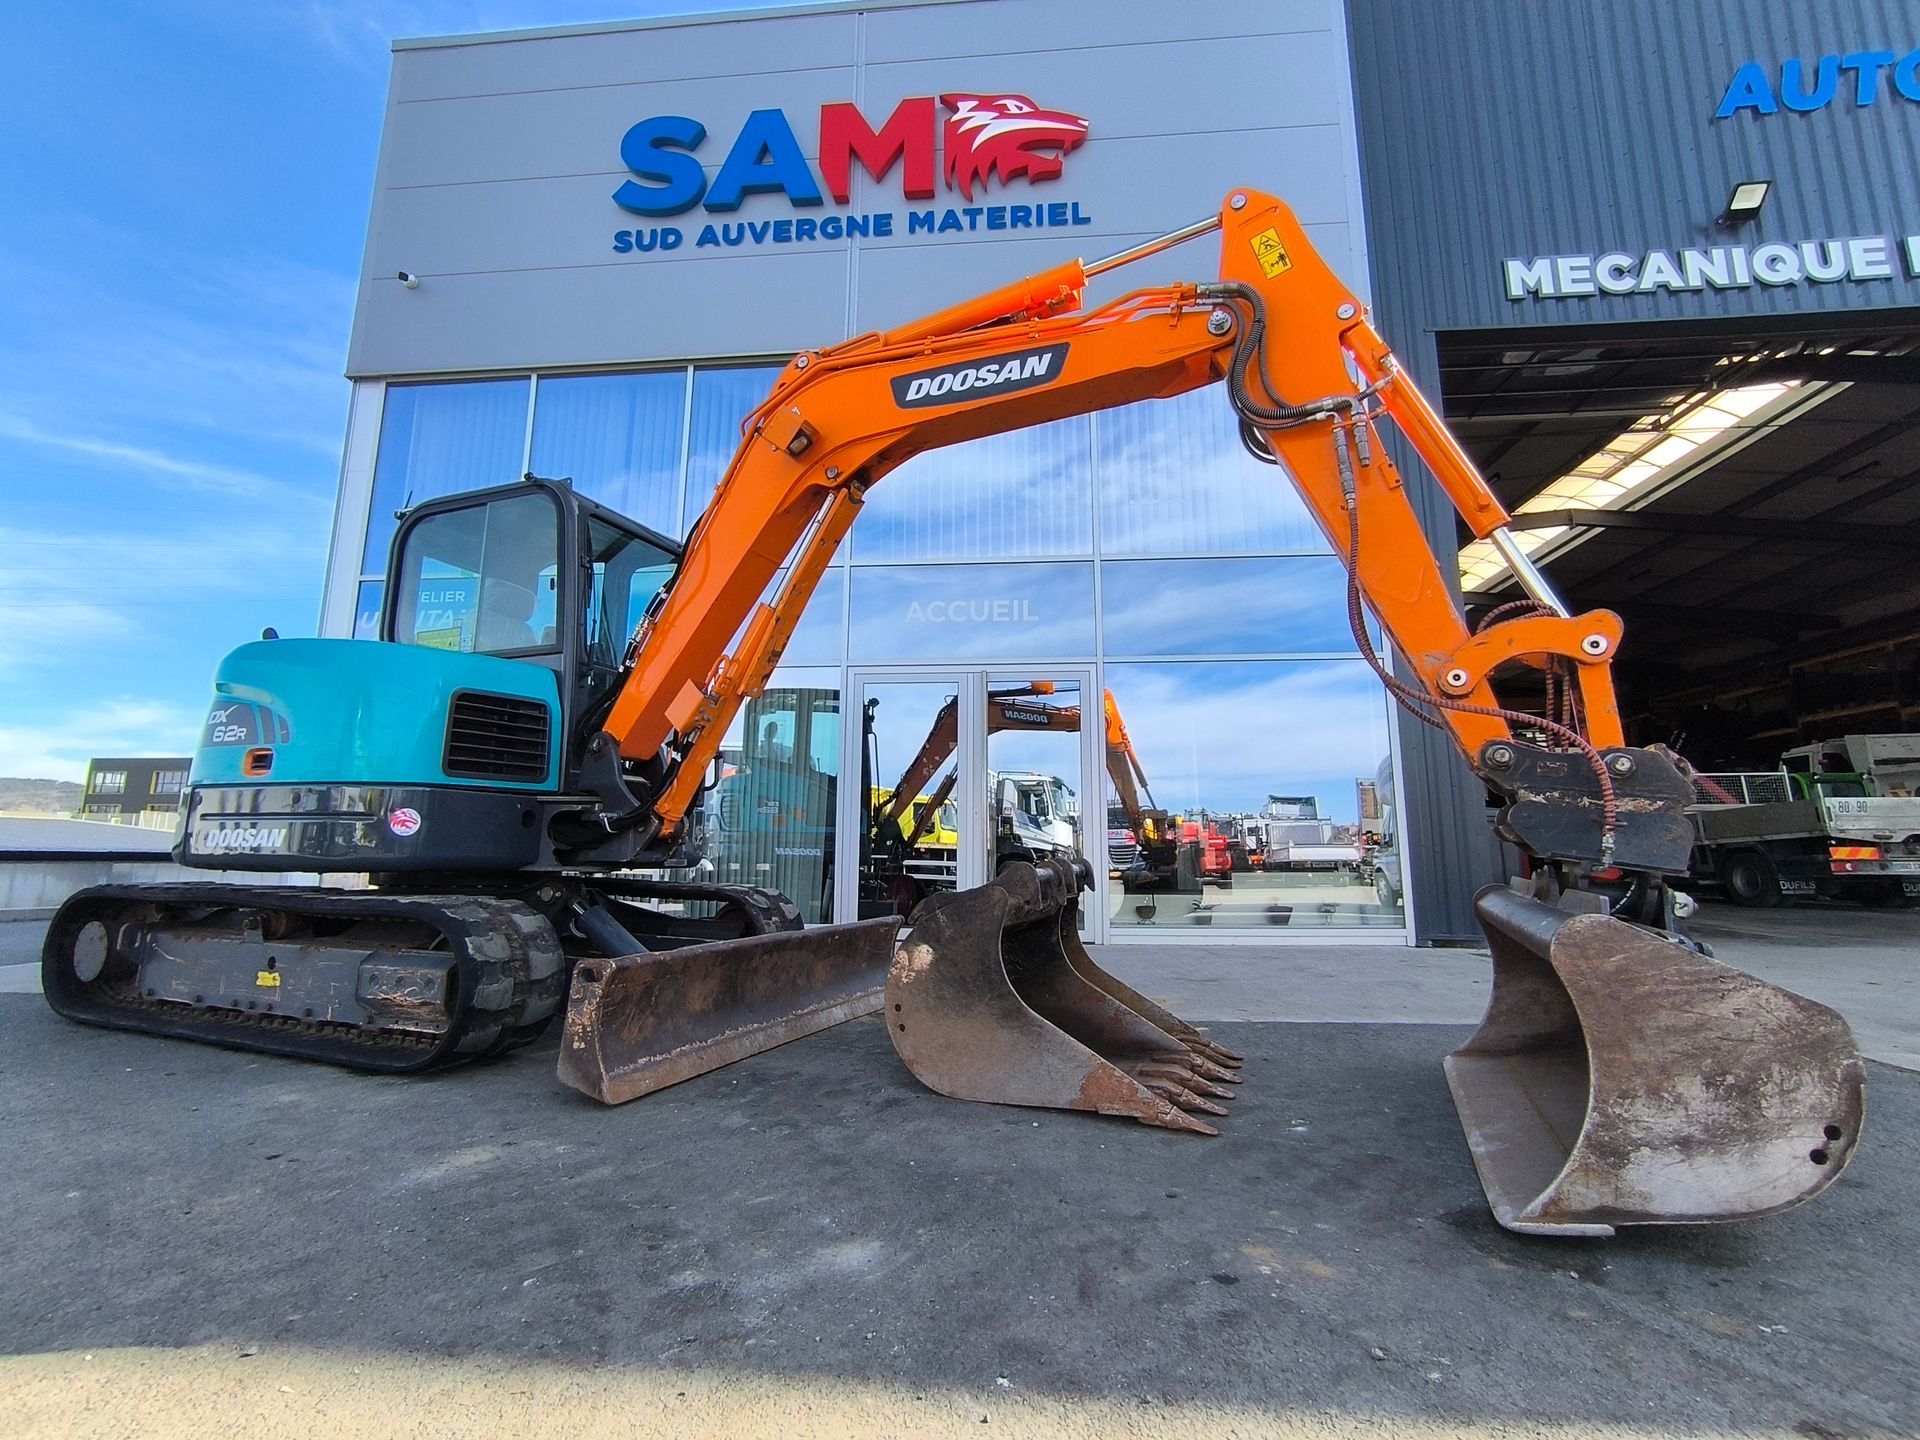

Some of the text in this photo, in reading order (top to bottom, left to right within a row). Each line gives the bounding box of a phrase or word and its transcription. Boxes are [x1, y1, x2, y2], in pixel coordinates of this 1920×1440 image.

[611, 96, 936, 217] SAM
[612, 202, 1091, 253] SUD AUVERGNE MATERIEL
[1504, 236, 1893, 300] MECANIQUE
[904, 351, 1053, 402] DOOSAN
[419, 590, 466, 603] ELIER
[905, 599, 1039, 622] ACCUEIL
[208, 704, 238, 724] DX
[213, 725, 247, 742] 62R
[1856, 801, 1868, 813] 90
[206, 828, 287, 849] DOOSAN
[1780, 880, 1816, 890] DUFILS
